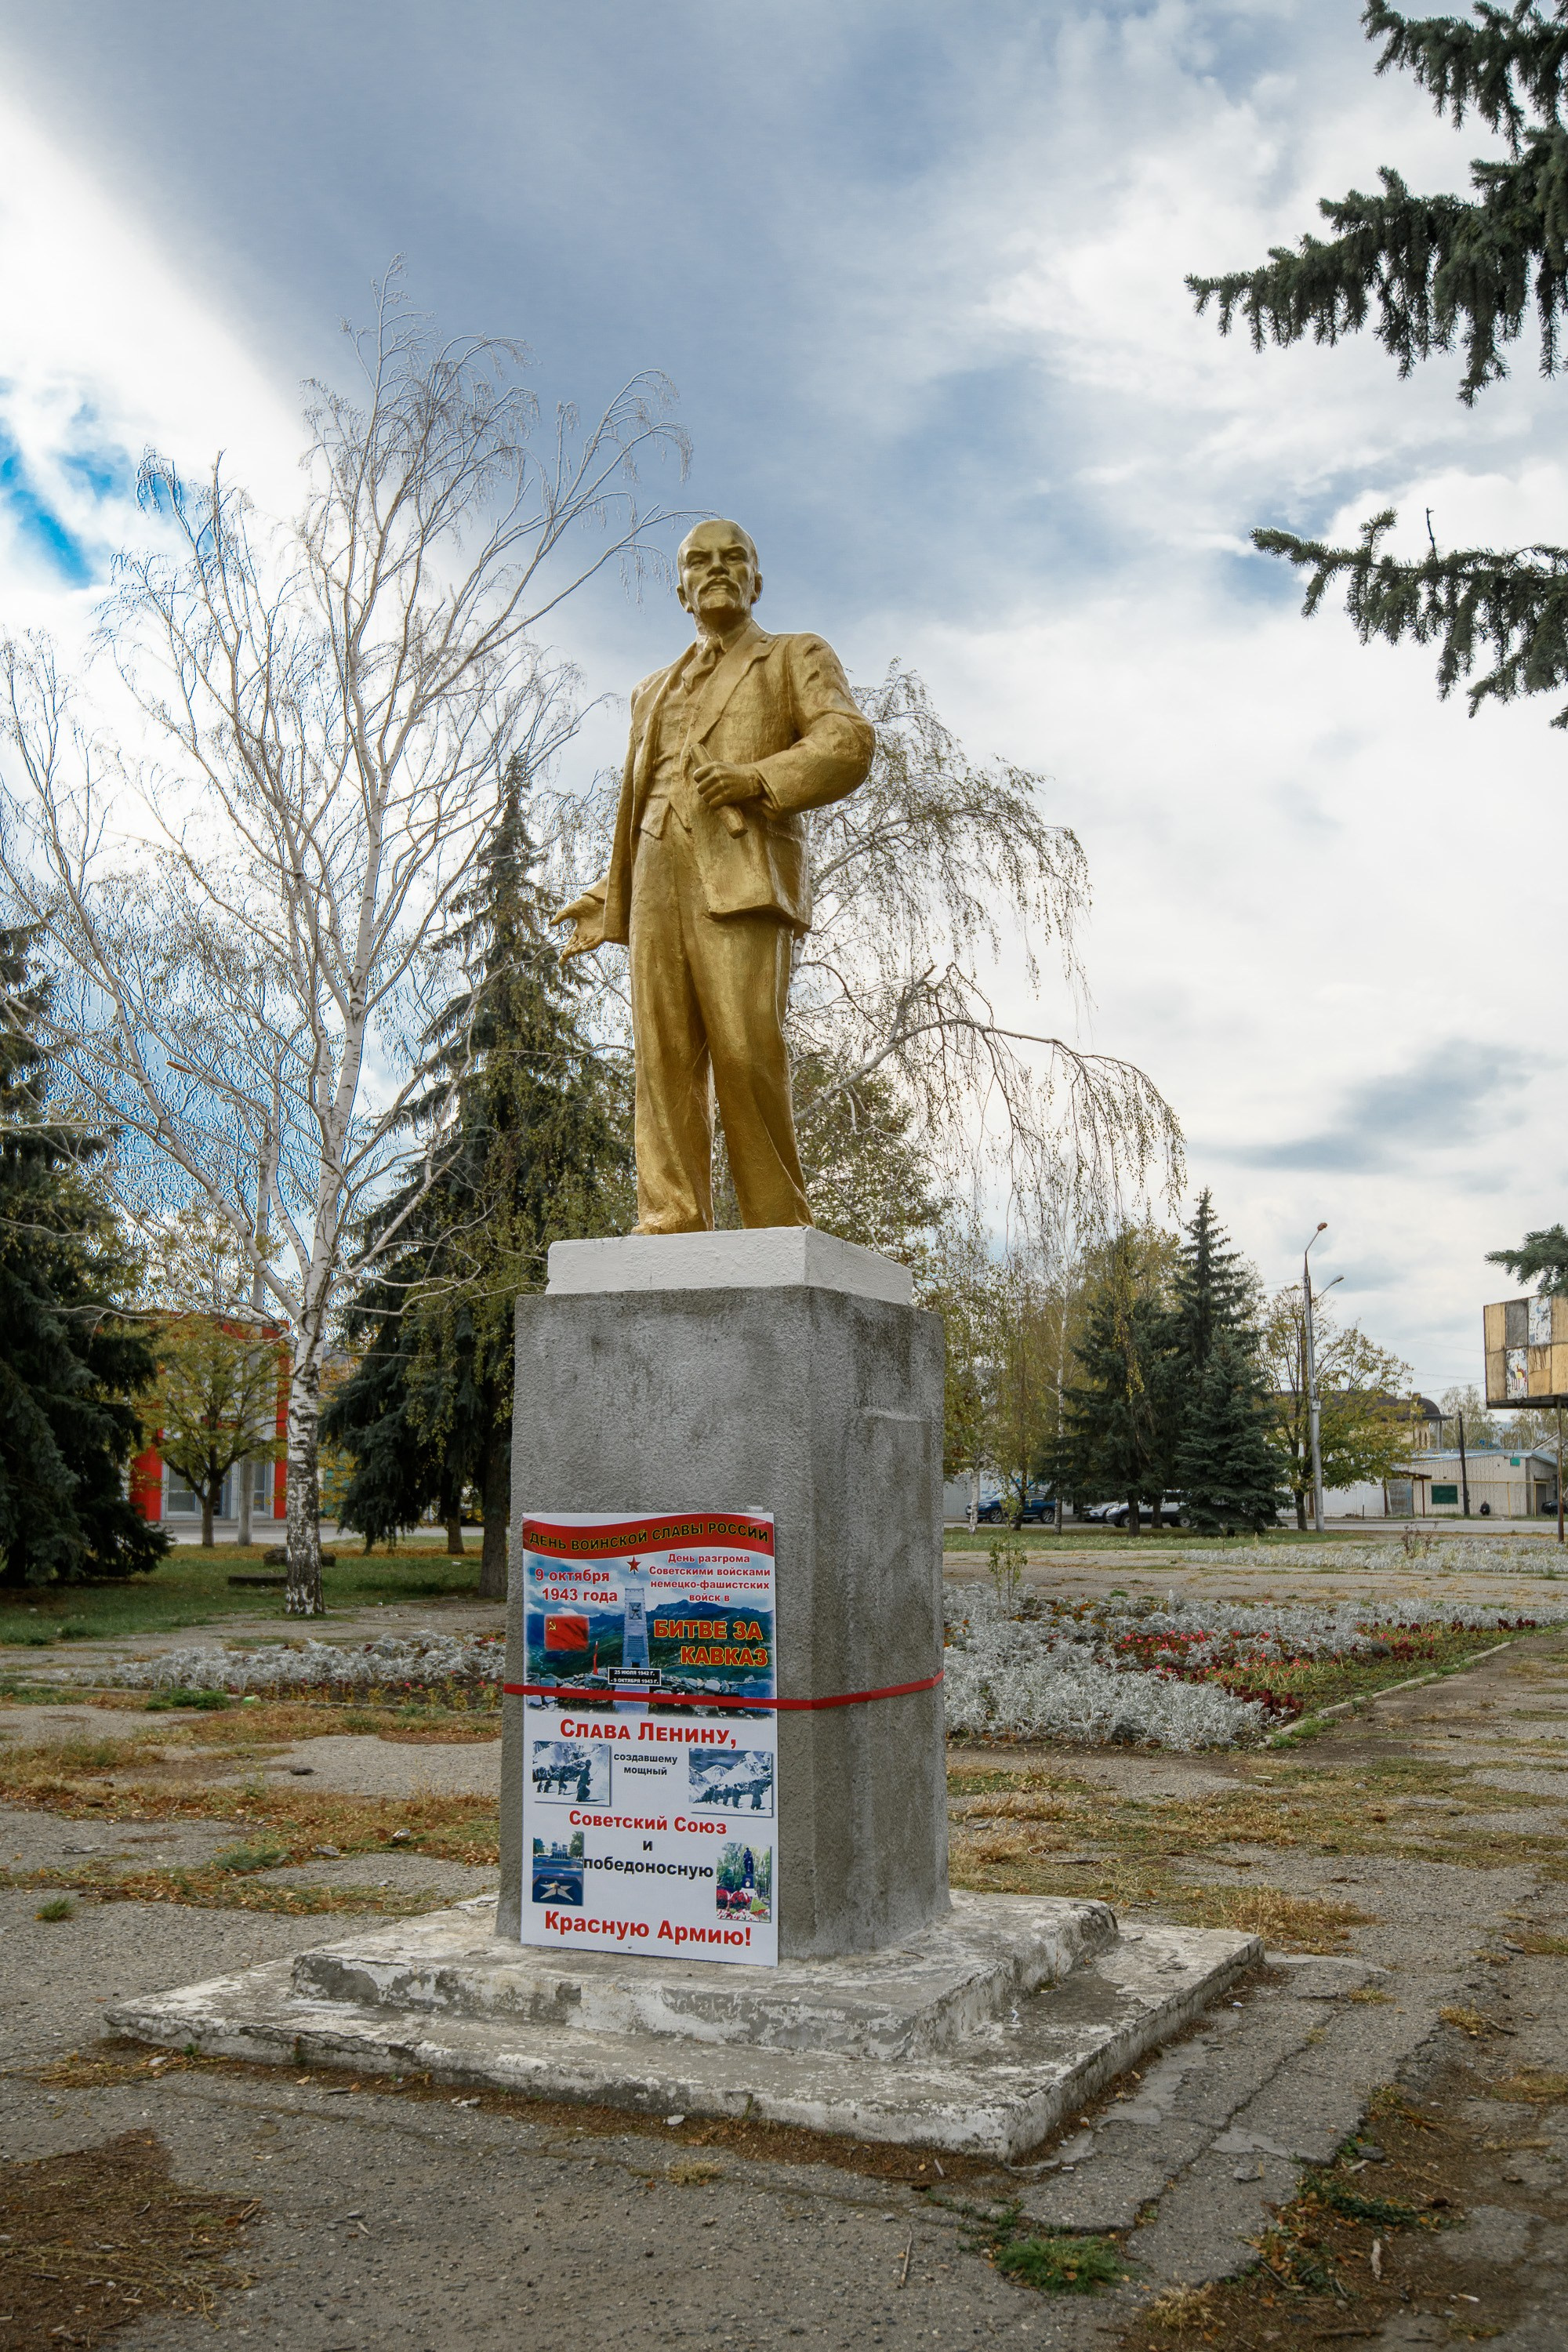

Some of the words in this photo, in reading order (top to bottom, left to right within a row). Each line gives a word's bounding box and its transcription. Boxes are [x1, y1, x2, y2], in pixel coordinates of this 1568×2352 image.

[529, 1532, 567, 1550] ДЕНЬ
[571, 1529, 648, 1551] ВОИНСКОЙ
[652, 1523, 704, 1541] СЛАВЫ
[707, 1522, 768, 1543] РОССИИ
[668, 1553, 695, 1563] День
[699, 1555, 750, 1565] разгрома
[535, 1568, 544, 1581] 9
[549, 1569, 610, 1585] октября
[649, 1566, 713, 1575] Советскими
[717, 1567, 771, 1577] войсками
[650, 1580, 770, 1591] немецко-фашистских
[542, 1587, 579, 1602] 1943
[583, 1591, 618, 1604] года
[689, 1593, 720, 1602] войск
[654, 1619, 728, 1639] БИТВЕ
[733, 1621, 763, 1640] ЗА
[681, 1646, 768, 1667] КАВКАЗ
[613, 1753, 678, 1765] создавшему
[623, 1766, 667, 1776] мощный
[568, 1809, 668, 1831] Советский
[673, 1816, 727, 1835] Союз
[642, 1840, 653, 1851] и
[583, 1856, 714, 1880] победоносную
[545, 1910, 650, 1940] Красную
[656, 1919, 752, 1947] Армию!
